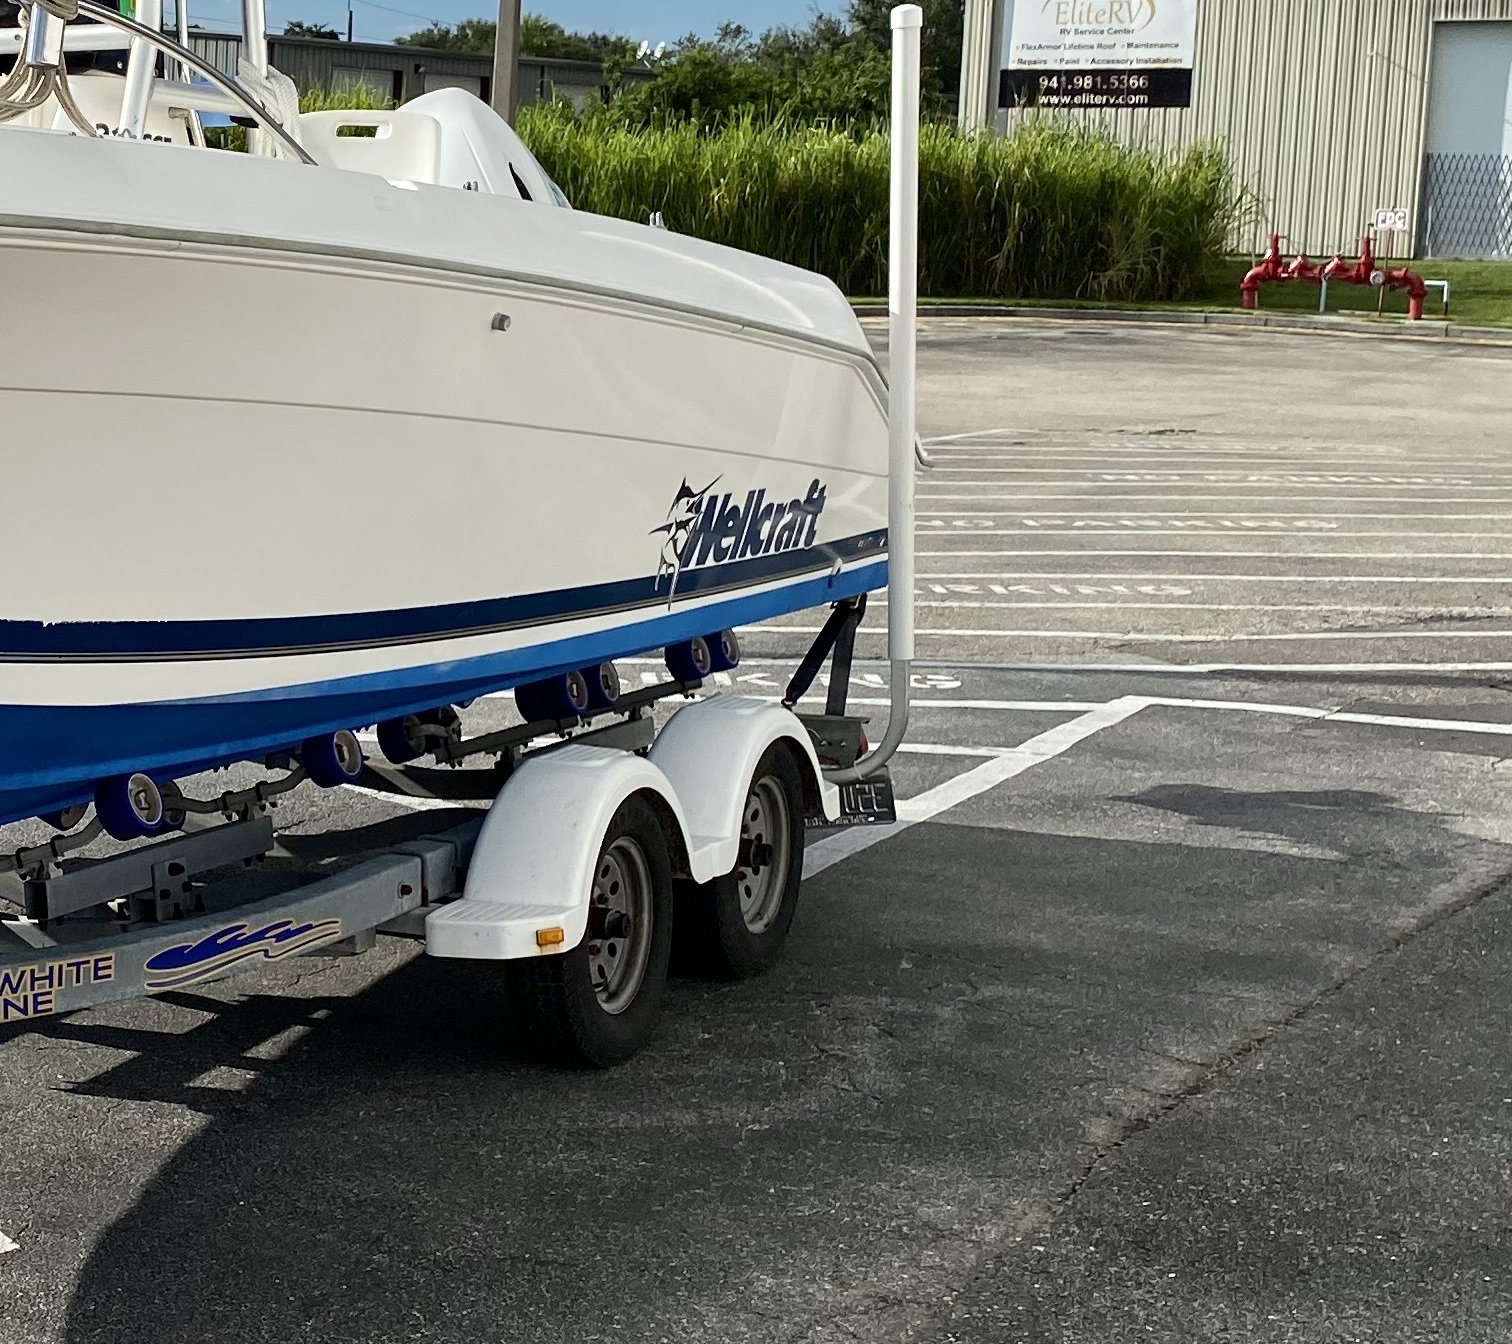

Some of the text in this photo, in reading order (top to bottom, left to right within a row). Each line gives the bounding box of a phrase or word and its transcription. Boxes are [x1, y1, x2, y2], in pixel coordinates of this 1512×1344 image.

[1059, 27, 1135, 36] RV Service Center
[1016, 58, 1048, 66] Repairs
[1090, 57, 1134, 66] Accessory
[1038, 74, 1149, 90] 941.981.5366
[1038, 92, 1149, 105] www.eliterv.com
[1378, 211, 1405, 227] FDC
[680, 478, 828, 569] Wellcraft
[913, 583, 1192, 596] RKING
